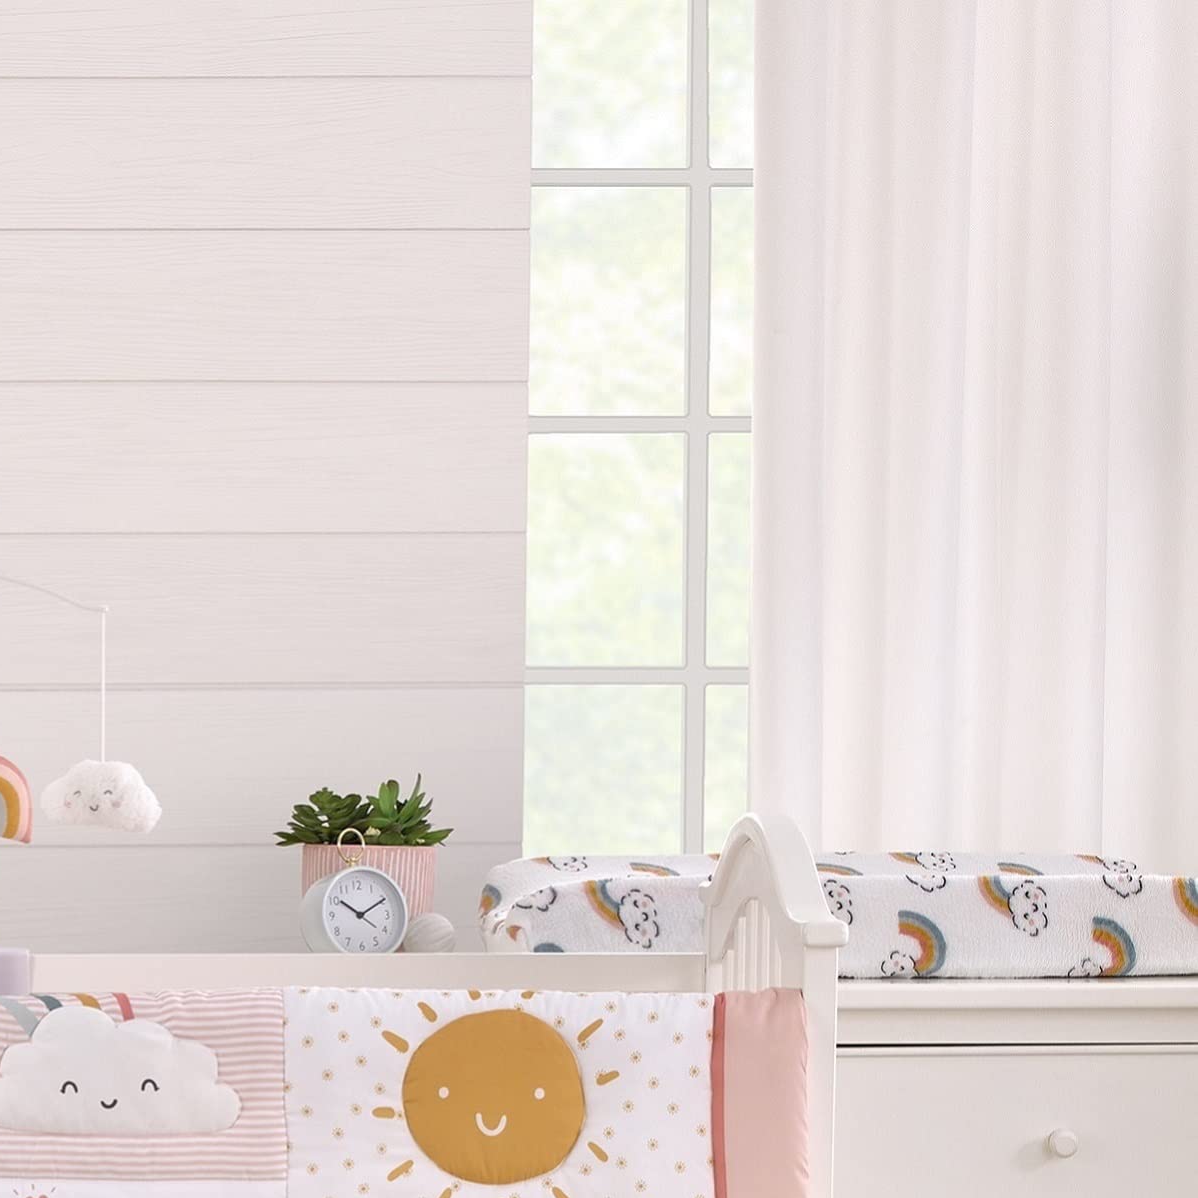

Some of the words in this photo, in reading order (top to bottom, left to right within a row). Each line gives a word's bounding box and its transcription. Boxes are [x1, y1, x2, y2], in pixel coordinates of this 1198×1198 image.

[352, 880, 362, 890] 12
[329, 896, 340, 906] 10
[328, 911, 335, 921] 9
[384, 910, 390, 920] 3
[333, 926, 340, 936] 8
[381, 926, 388, 935] 4
[345, 936, 351, 947] 7
[359, 940, 366, 951] 6
[372, 936, 379, 947] 5
